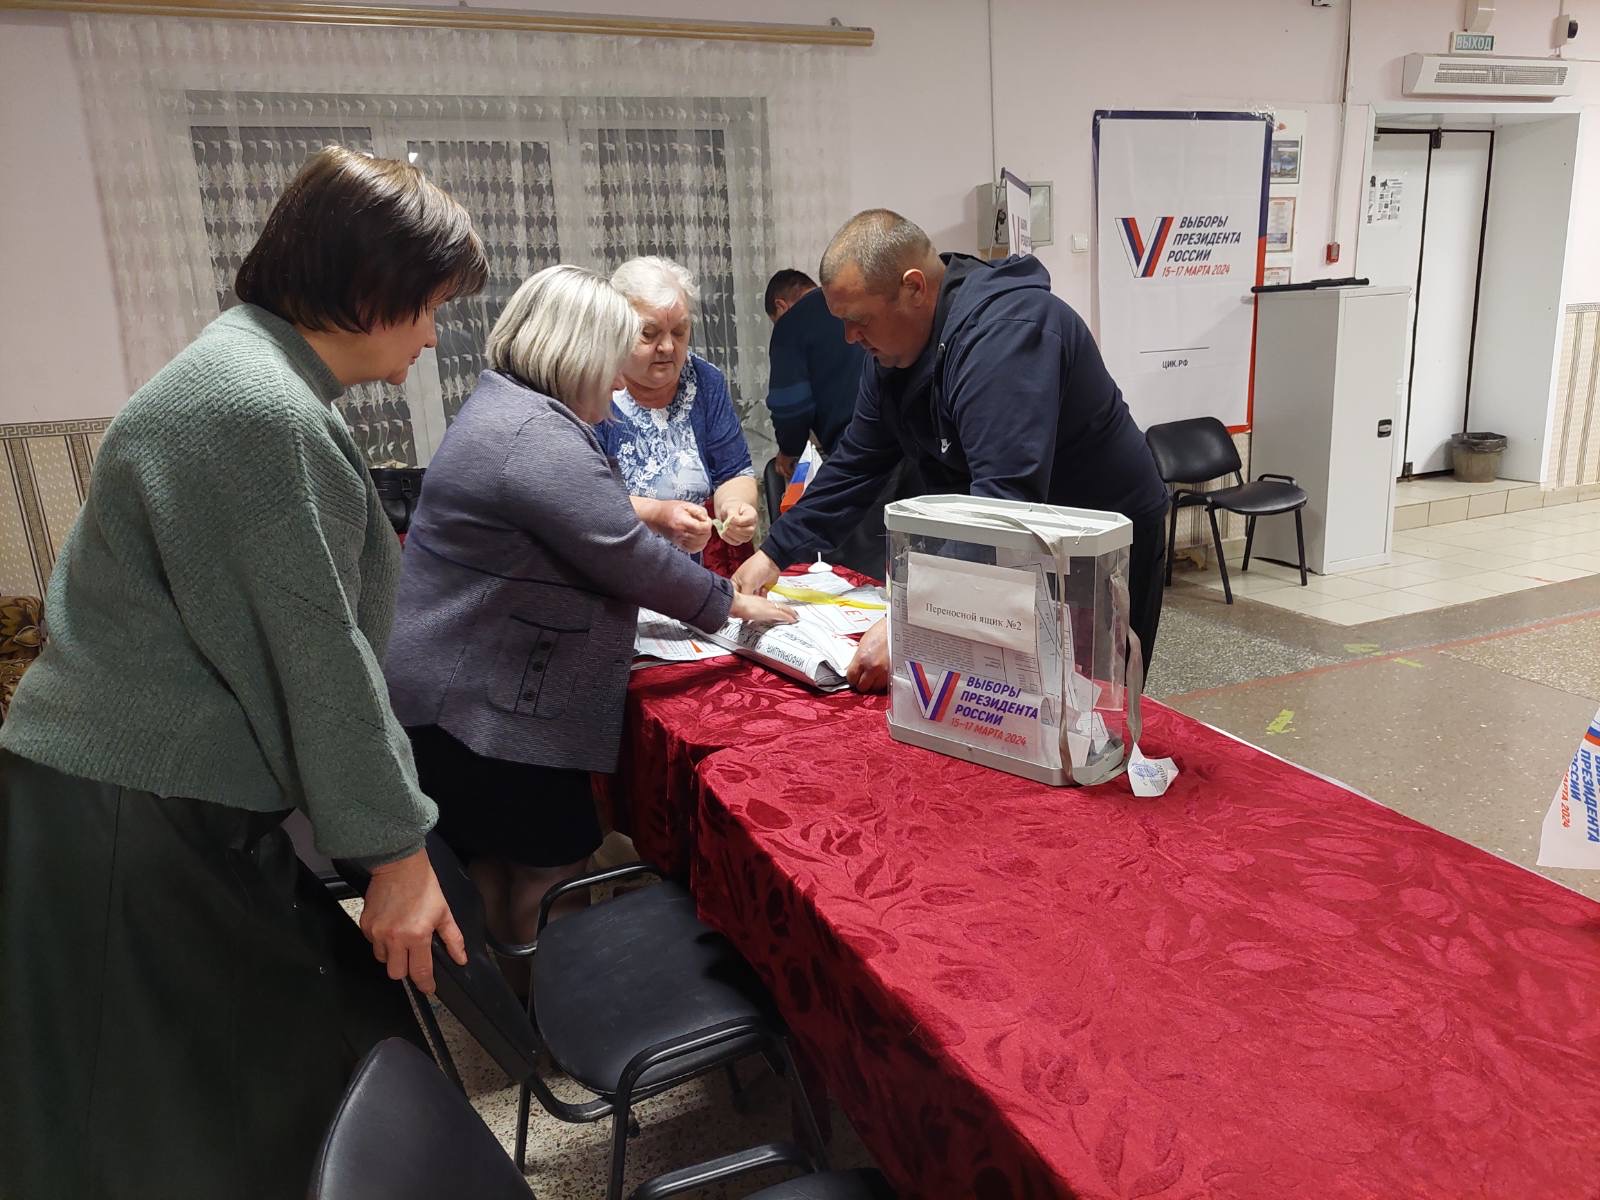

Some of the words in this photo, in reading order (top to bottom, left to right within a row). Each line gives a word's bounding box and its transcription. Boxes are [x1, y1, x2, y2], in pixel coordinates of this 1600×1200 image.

[1456, 36, 1492, 50] ВЫХОД
[1179, 216, 1228, 228] ВЫБОРЫ
[1173, 232, 1241, 246] ПРЕЗИДЕНТА
[1167, 249, 1212, 262] РОССИИ
[1184, 265, 1210, 276] МАРТА
[1211, 264, 1230, 275] 2024
[1162, 359, 1188, 370] ЦИК.РФ
[925, 602, 977, 622] Переносной
[979, 615, 1004, 628] ящик
[1005, 618, 1022, 631] №2
[966, 676, 1021, 698] ВЫБОРЫ
[955, 704, 1004, 726] РОССИИ
[960, 690, 1039, 720] ПРЕЗИДЕНТА
[974, 724, 1004, 739] МАРТА
[1004, 732, 1027, 746] 2024
[1581, 748, 1600, 842] ПРЕЗИДЕНТА
[1561, 803, 1570, 828] 2024
